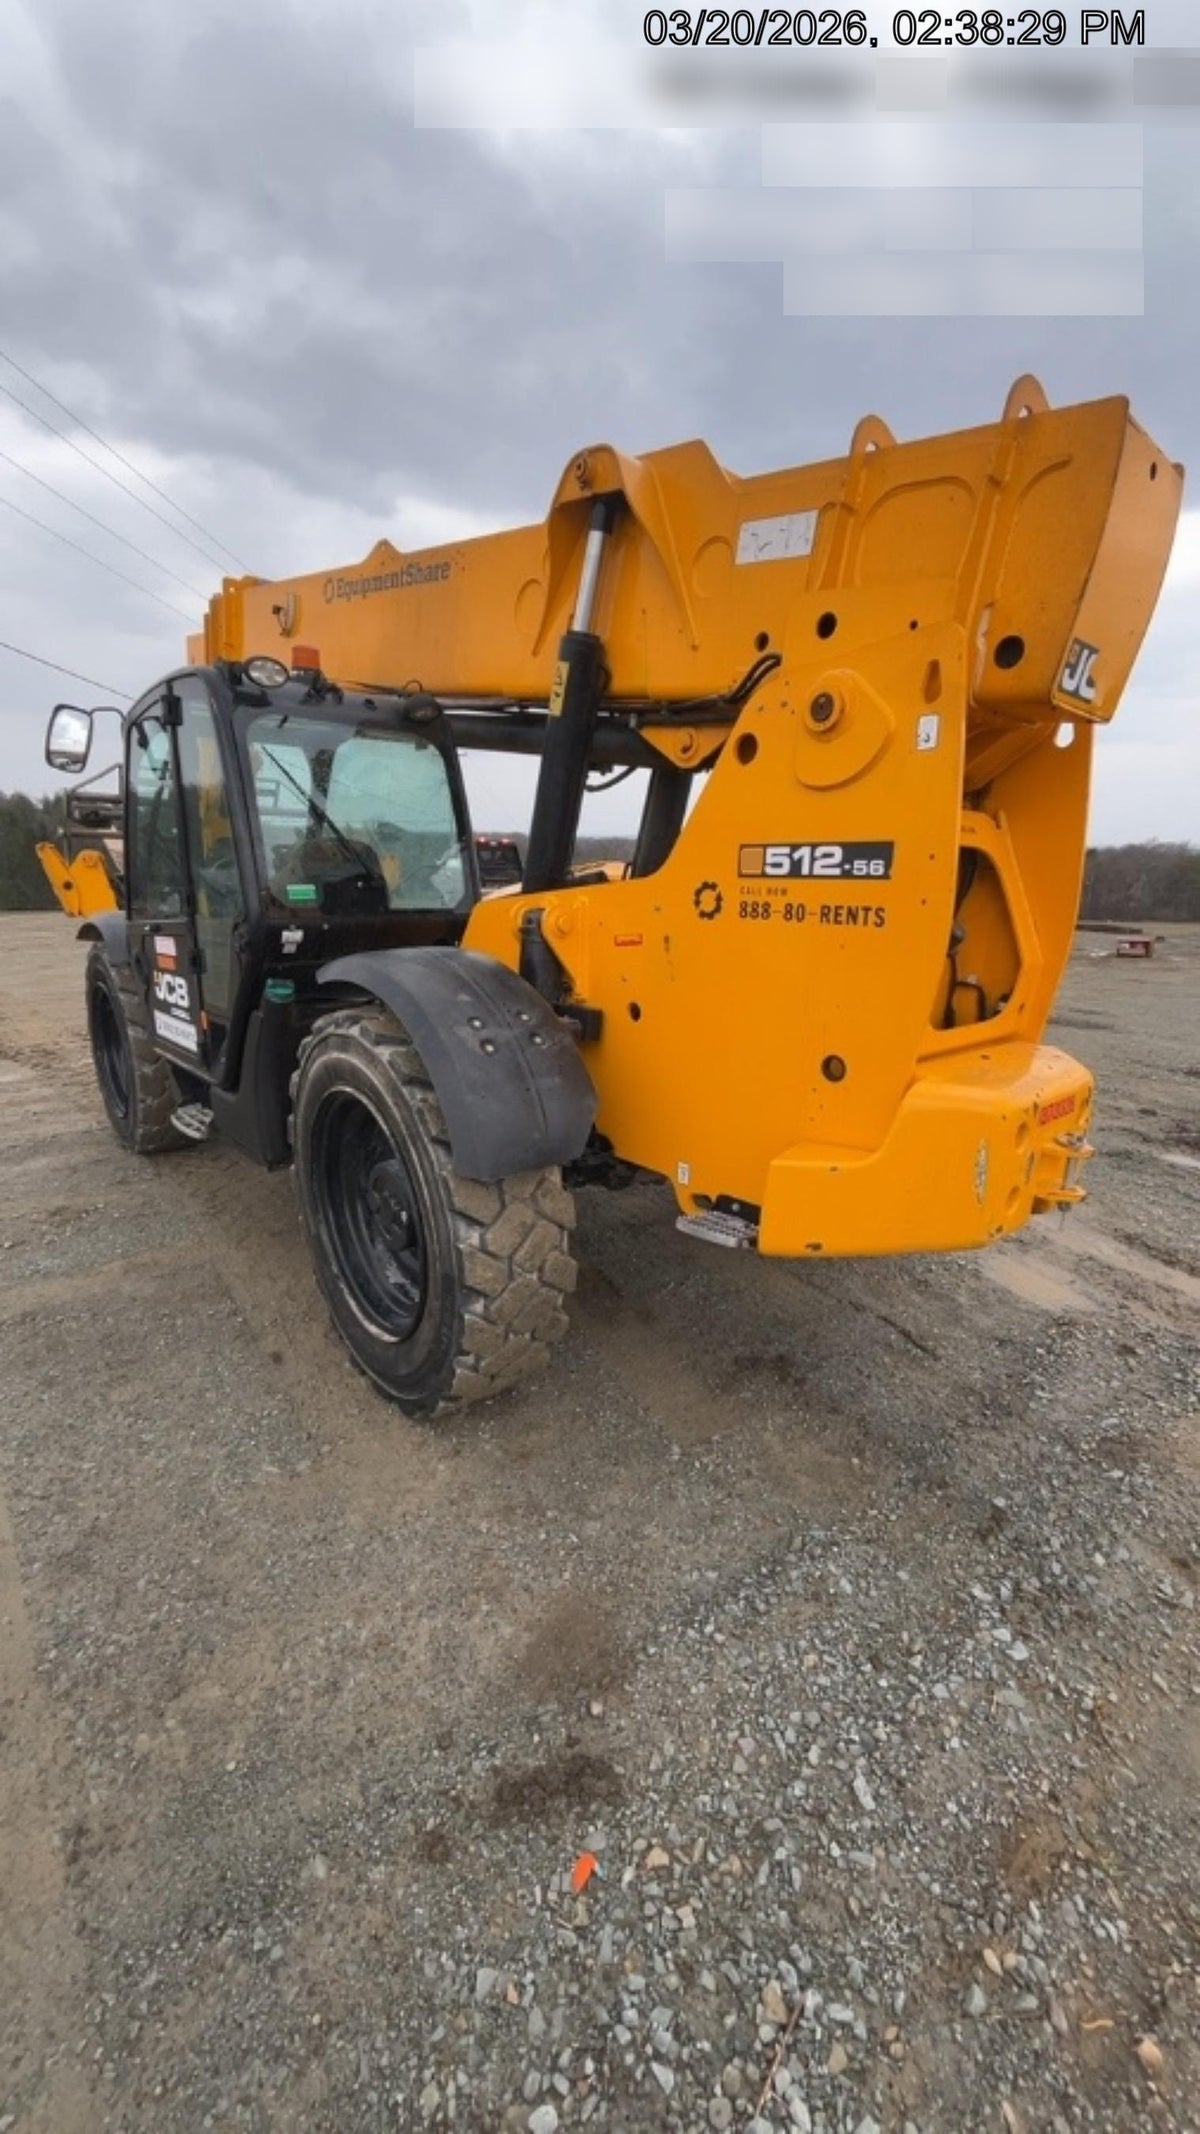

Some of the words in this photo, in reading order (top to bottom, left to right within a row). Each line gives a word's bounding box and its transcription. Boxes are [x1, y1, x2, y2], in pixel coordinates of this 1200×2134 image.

[337, 562, 450, 602] EquipmentShare
[764, 845, 885, 875] 512-56
[739, 901, 886, 927] 888-80-RENTS
[154, 972, 190, 1008] JCB
